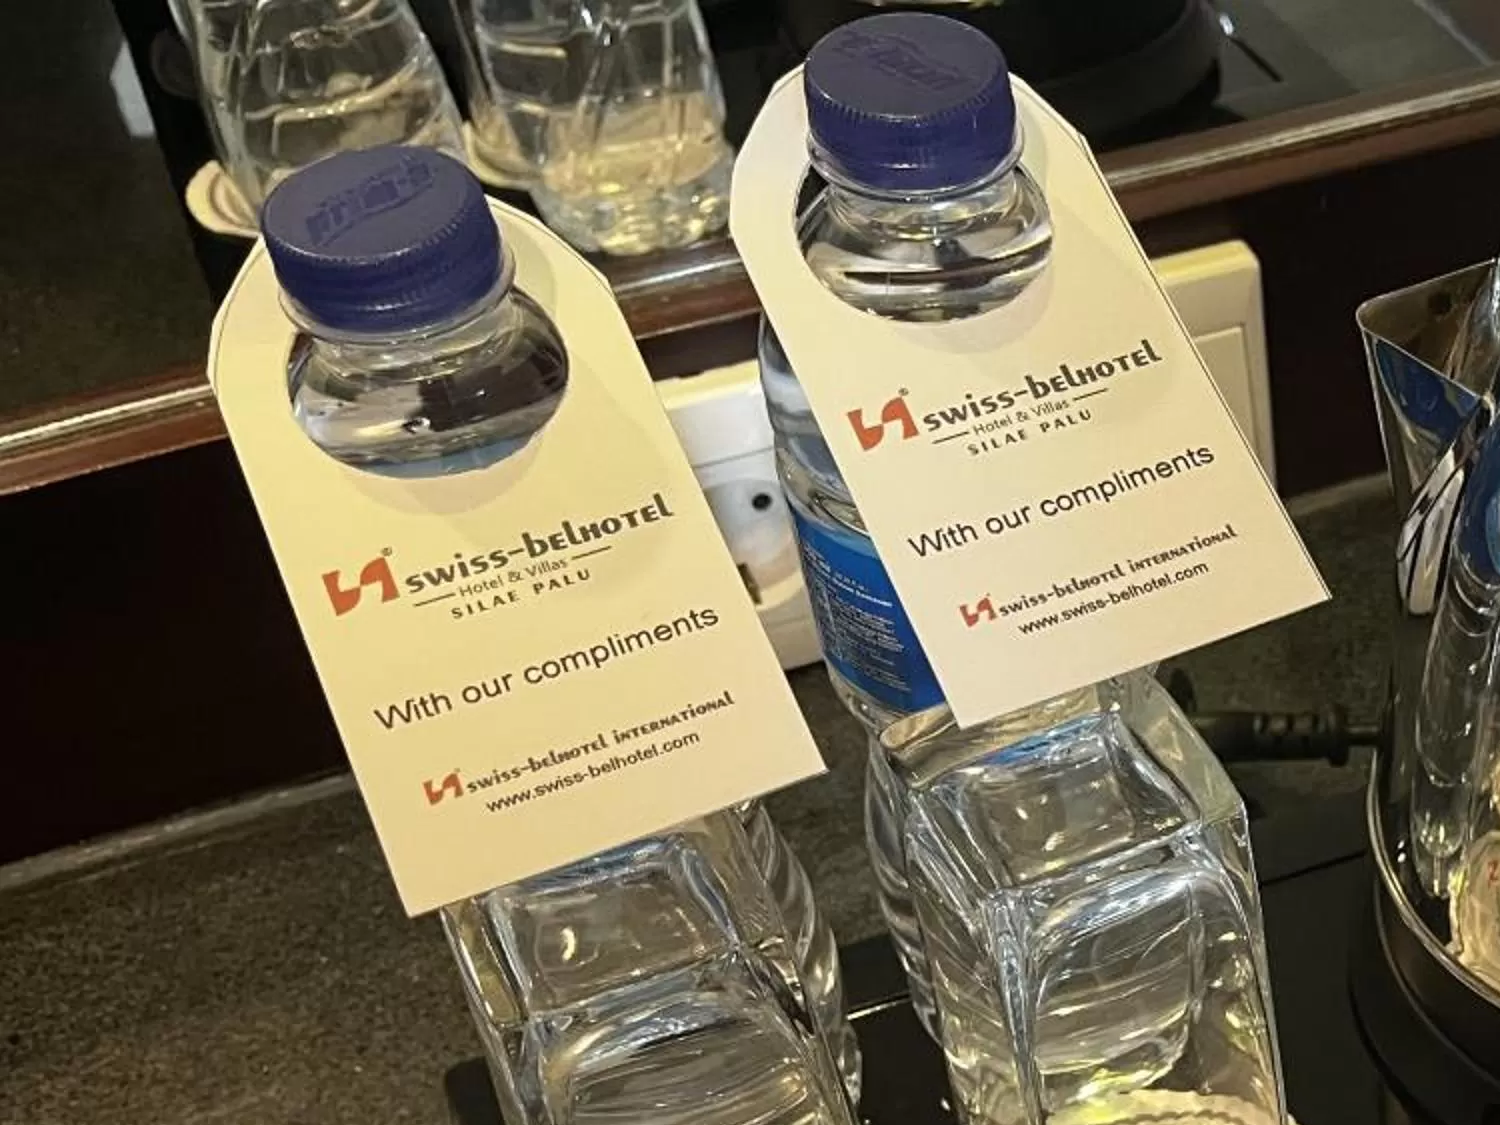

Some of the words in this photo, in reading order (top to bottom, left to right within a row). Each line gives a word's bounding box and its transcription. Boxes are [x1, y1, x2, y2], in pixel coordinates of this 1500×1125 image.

[967, 429, 1029, 456] SILAE
[1040, 409, 1092, 434] PALU
[973, 416, 1014, 436] Hotel
[1016, 410, 1030, 424] &
[1030, 398, 1070, 419] Villas
[907, 524, 978, 557] With
[985, 505, 1032, 536] our
[1040, 446, 1215, 518] compliments
[451, 590, 520, 620] SILAE
[532, 568, 592, 596] PALU
[458, 574, 504, 598] Hotel
[508, 568, 525, 583] &
[524, 557, 568, 579] Villas
[1018, 561, 1209, 636] www.swiss-belhotel.com
[374, 693, 452, 731] With
[462, 673, 512, 704] our
[524, 606, 720, 685] compliments
[485, 731, 700, 814] www.swiss-belhotel.com
